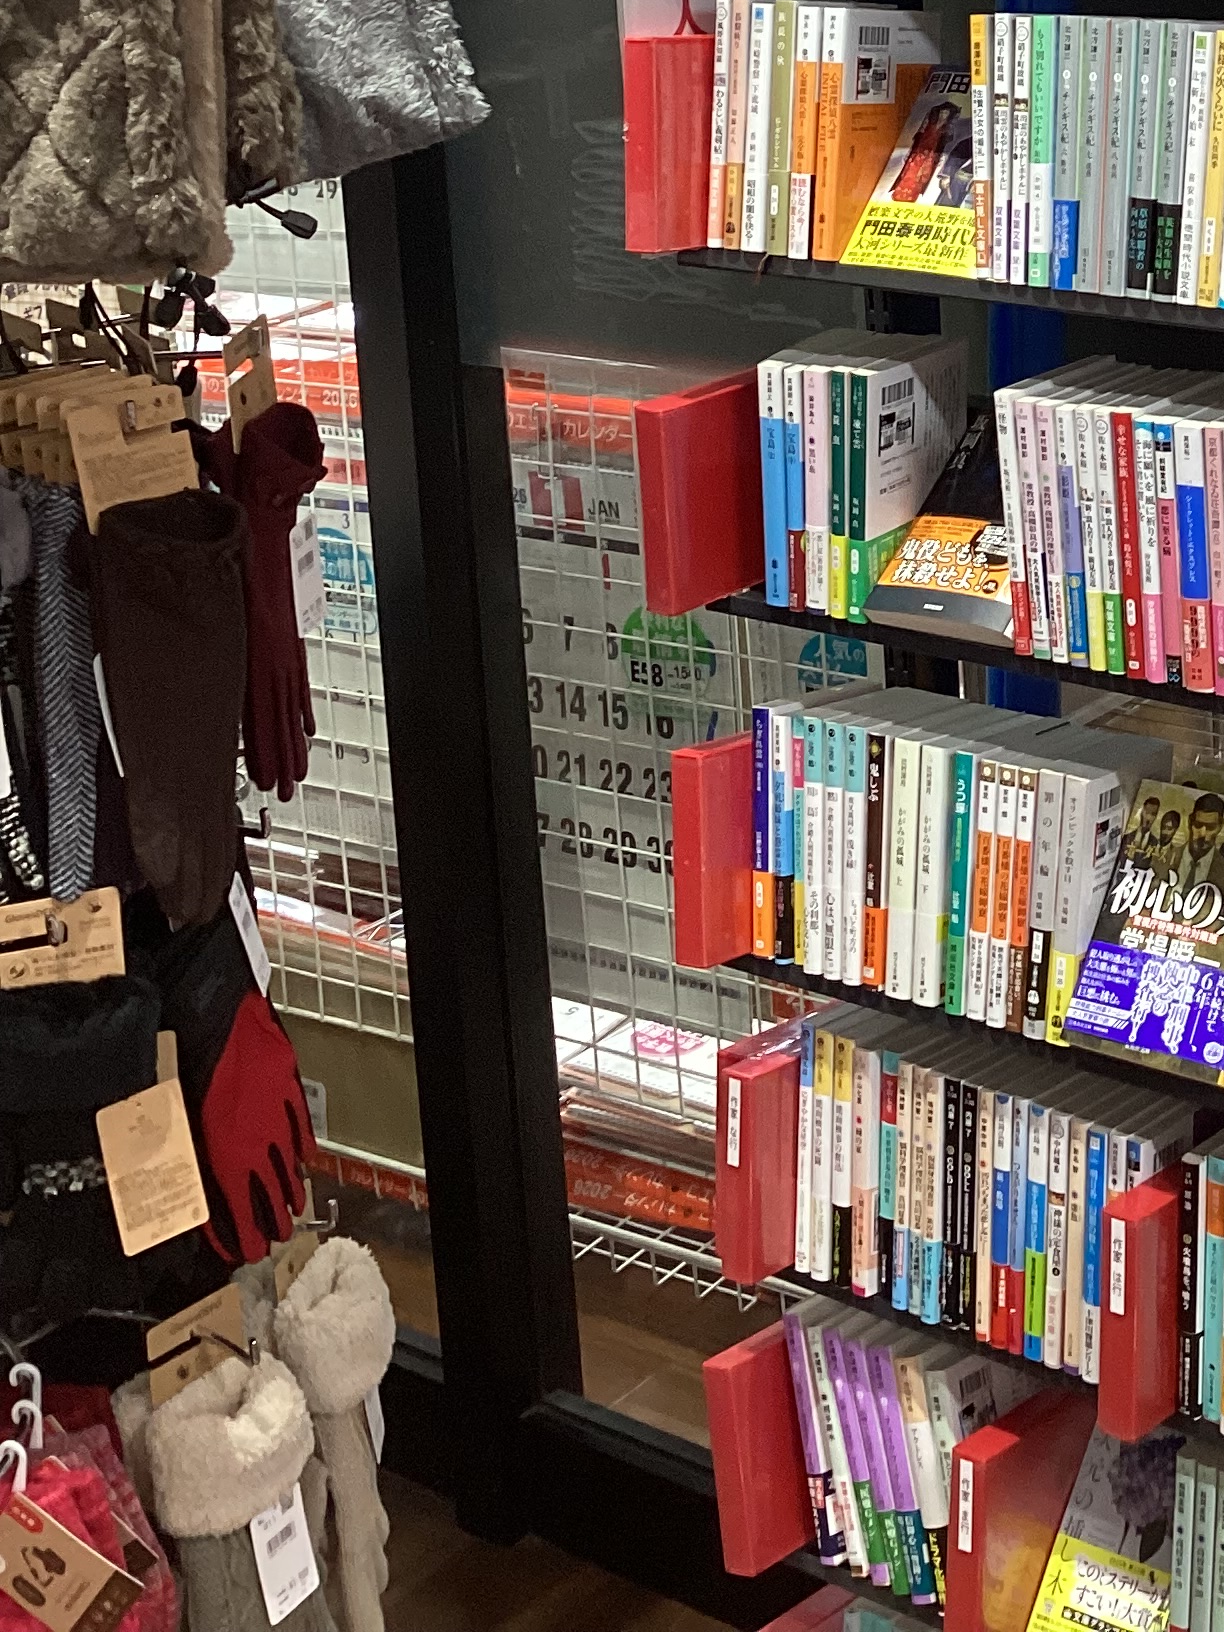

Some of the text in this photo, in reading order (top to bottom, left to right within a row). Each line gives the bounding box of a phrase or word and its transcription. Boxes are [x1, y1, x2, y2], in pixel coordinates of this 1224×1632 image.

[1033, 27, 1045, 146] もう別れてもいいですか
[1060, 91, 1070, 146] チンギス紀
[1086, 94, 1096, 148] チンギス紀
[1110, 93, 1121, 149] チンギス紀
[1137, 98, 1147, 150] チンギス紀
[1164, 99, 1176, 153] チンギス紀
[588, 498, 620, 519] JAN
[555, 681, 587, 721] 14
[598, 688, 630, 730] 15
[1112, 1237, 1123, 1264] 作家
